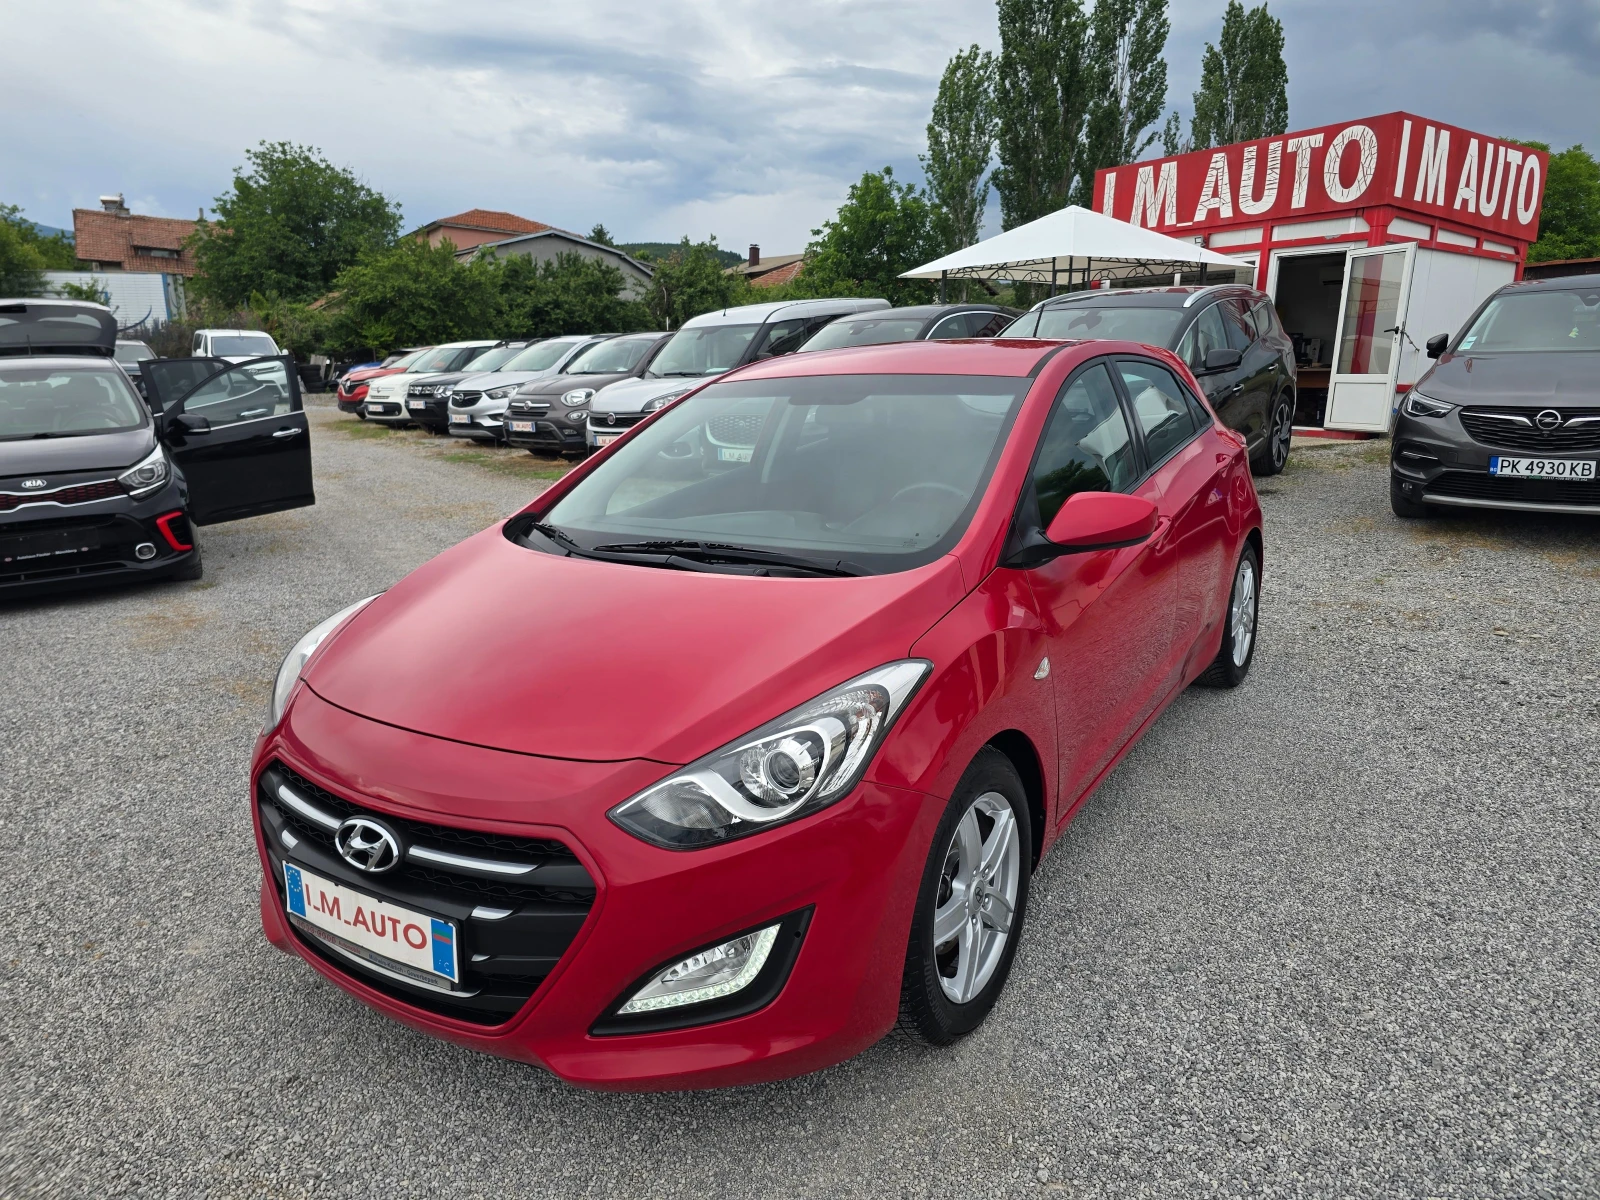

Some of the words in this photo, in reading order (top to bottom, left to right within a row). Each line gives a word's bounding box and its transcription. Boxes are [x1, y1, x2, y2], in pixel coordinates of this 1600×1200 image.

[1394, 119, 1412, 198] I
[1414, 125, 1450, 206] M
[1453, 137, 1541, 225] AUTO
[1500, 459, 1521, 474] PK
[1525, 460, 1566, 476] 4930
[1569, 462, 1592, 477] KB
[24, 479, 45, 488] KIA
